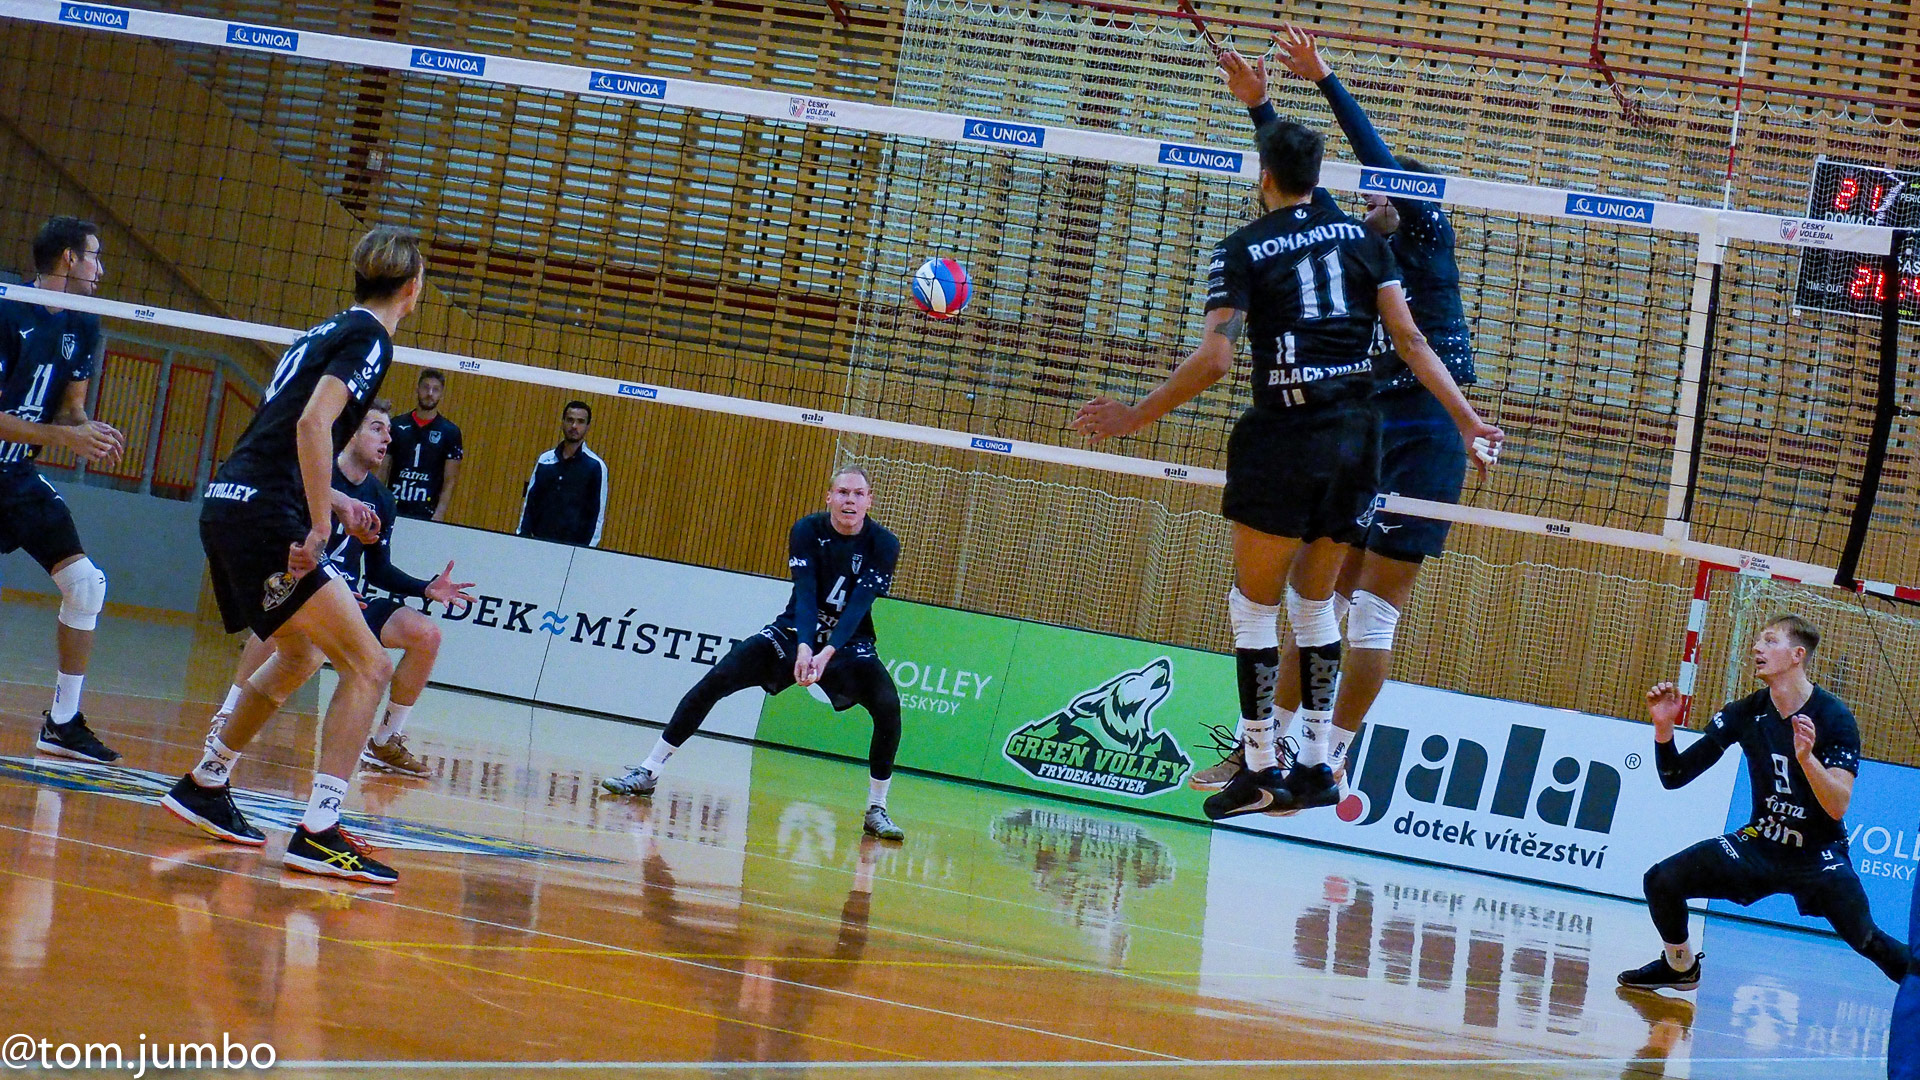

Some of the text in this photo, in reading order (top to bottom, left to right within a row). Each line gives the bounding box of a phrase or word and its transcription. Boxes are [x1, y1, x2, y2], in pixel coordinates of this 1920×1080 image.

[84, 10, 122, 26] UNIQA
[252, 32, 292, 48] UNIQA
[437, 56, 479, 73] UNIQA
[616, 79, 660, 96] UNIQA
[992, 127, 1037, 145] UNIQA
[1188, 152, 1235, 169] UNIQA
[1389, 177, 1438, 195] UNIQA
[1835, 178, 1882, 212] 21
[1596, 202, 1646, 220] UNIQA
[1292, 246, 1351, 320] 11
[459, 360, 480, 370] gala
[24, 363, 53, 406] 11
[1268, 366, 1324, 386] BLACK
[632, 388, 655, 398] UNIQA
[801, 412, 824, 423] gala
[413, 443, 421, 468] 1
[985, 441, 1009, 452] UNIQA
[1164, 467, 1188, 477] gala
[1545, 522, 1571, 533] gala
[825, 575, 847, 612] 4
[1006, 734, 1189, 785] GREEN VOLLEY
[1770, 753, 1792, 795] 9
[1393, 810, 1609, 870] dotek vítězství
